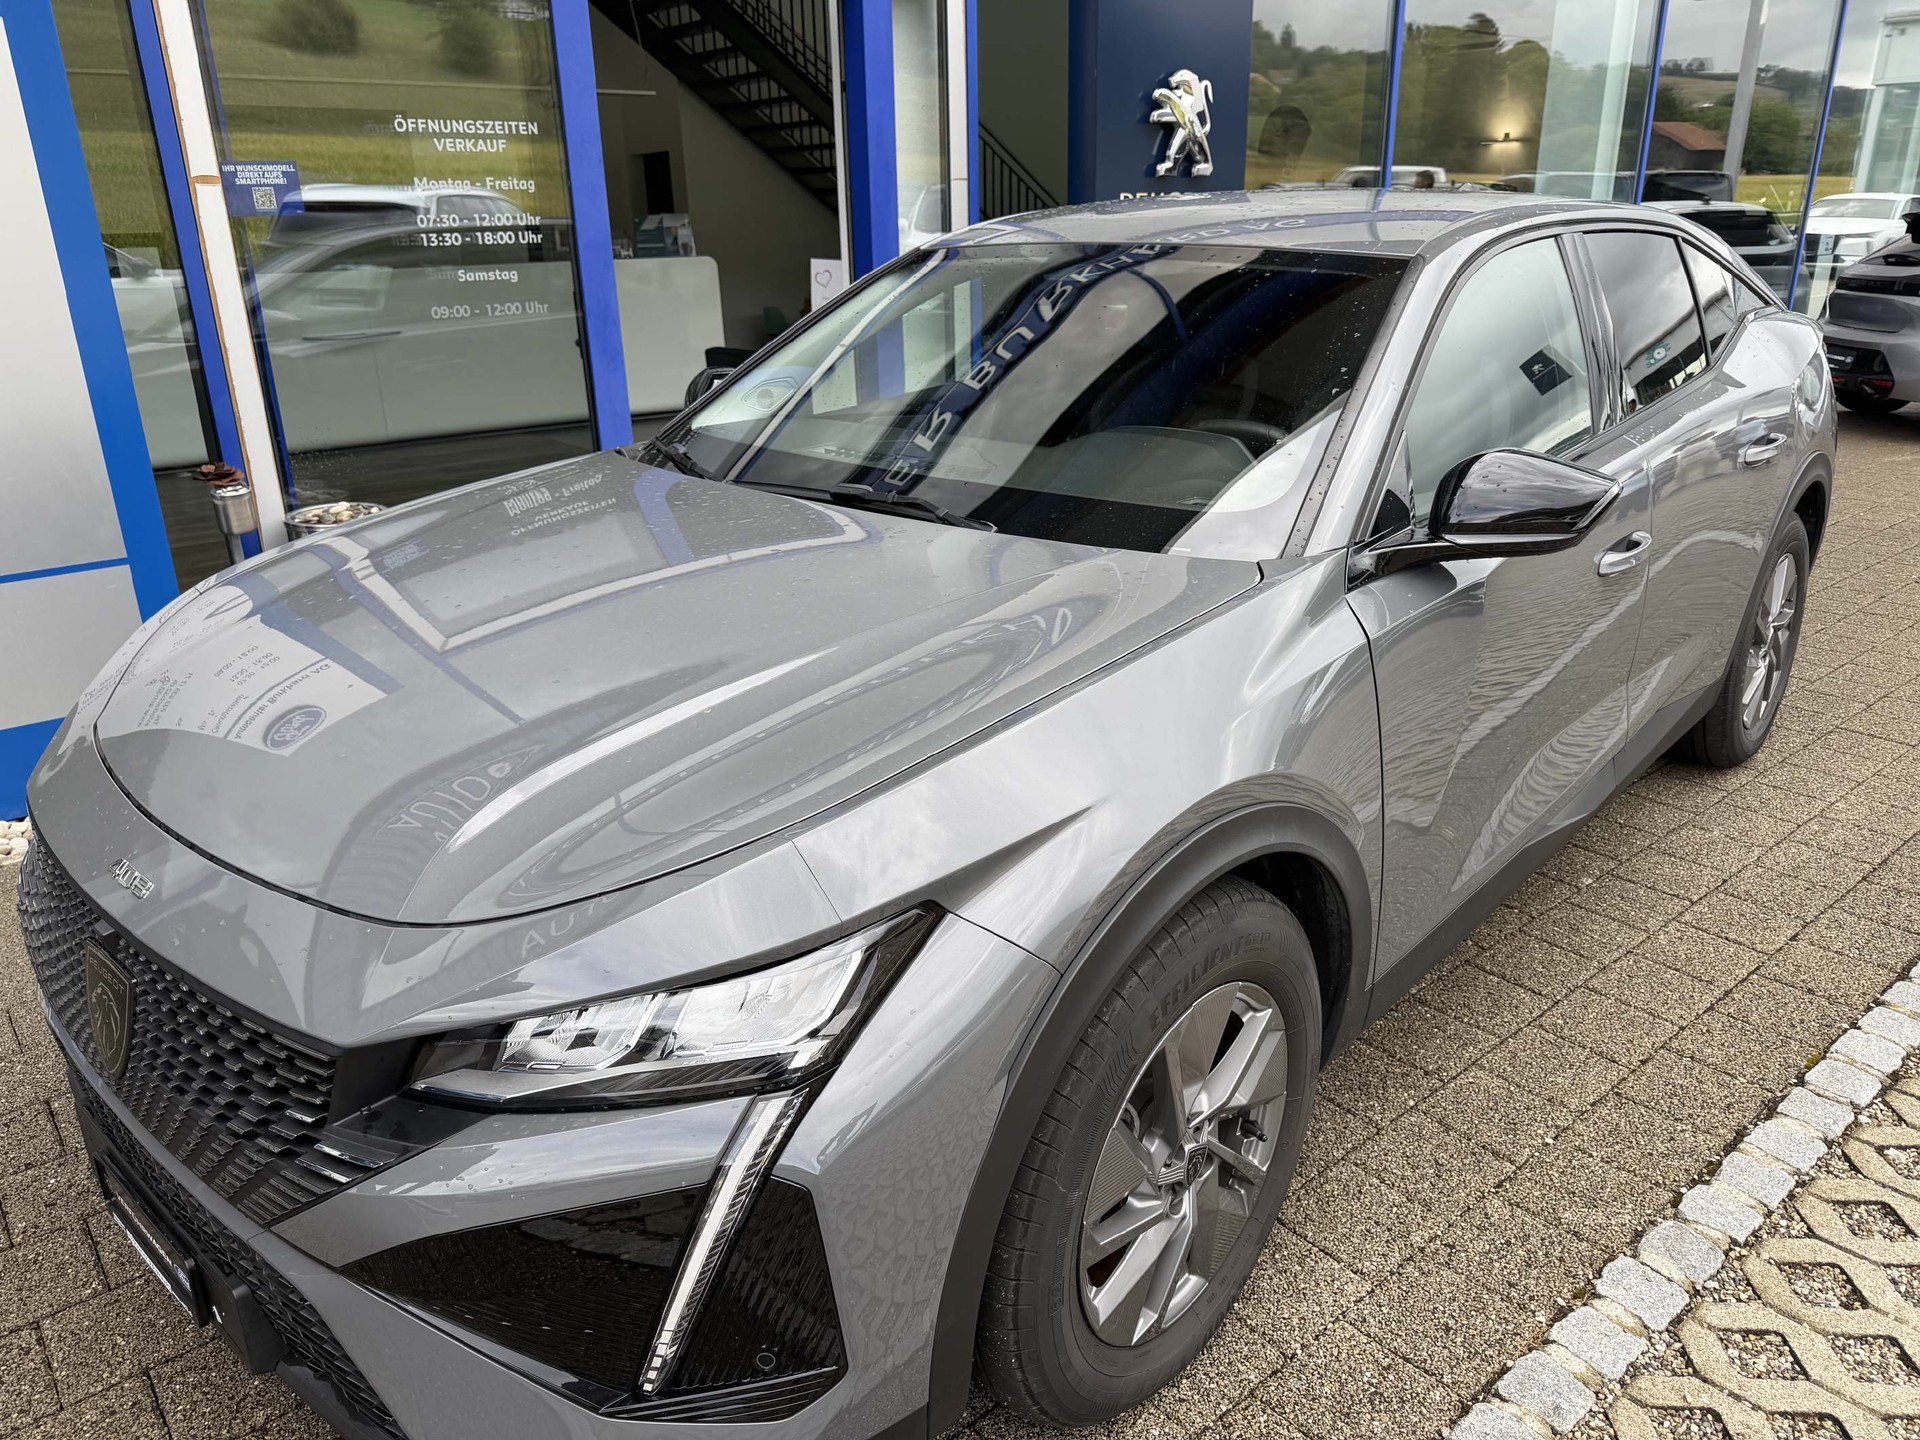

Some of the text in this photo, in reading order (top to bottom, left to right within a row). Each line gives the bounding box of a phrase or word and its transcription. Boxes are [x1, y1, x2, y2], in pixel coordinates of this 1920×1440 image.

[394, 115, 539, 135] ÖFFNUNGSZEITEN
[433, 138, 507, 152] VERKAUF
[221, 164, 296, 172] IHR WUNSCHMODELL
[234, 177, 288, 185] SMARTPHONE!
[413, 176, 471, 192] Montag
[485, 176, 536, 193] Freitag
[416, 213, 460, 228] 07:30
[473, 212, 513, 227] 12:00
[516, 212, 541, 226] Uhr
[420, 232, 462, 247] 13:30
[475, 231, 516, 245] 18:00
[518, 231, 543, 245] Uhr
[457, 269, 518, 283] Samstag
[431, 304, 471, 319] 09:00
[485, 302, 522, 317] 12:00
[525, 300, 549, 315] Uhr
[109, 858, 155, 899] 408
[89, 956, 125, 995] PEUGEOT
[1151, 935, 1244, 1033] EFFICIENT
